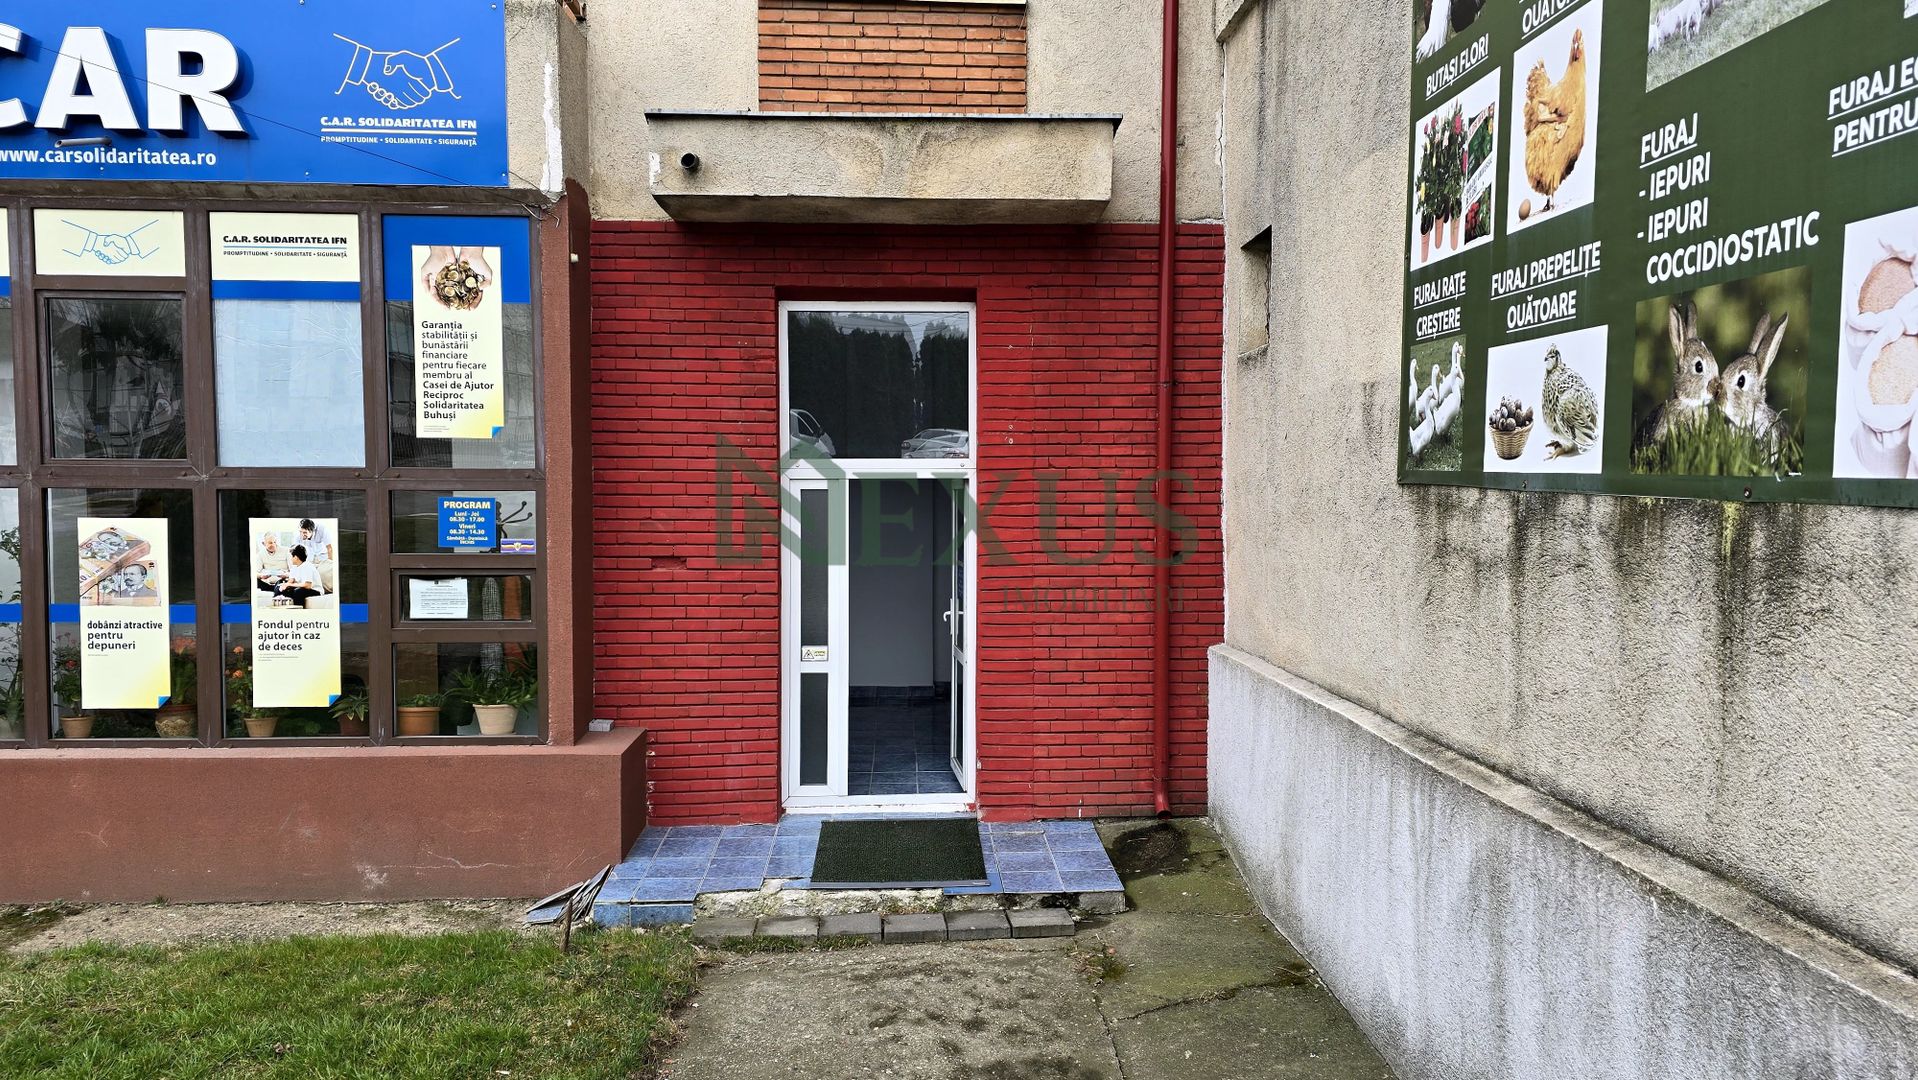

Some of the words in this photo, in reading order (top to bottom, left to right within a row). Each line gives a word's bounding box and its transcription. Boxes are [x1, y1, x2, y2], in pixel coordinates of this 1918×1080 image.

[1460, 33, 1489, 71] FLORI
[1829, 64, 1895, 115] FURAJ
[1900, 56, 1918, 88] E
[320, 117, 356, 126] C.A.R.
[358, 117, 453, 129] SOLIDARITATEA
[456, 119, 477, 129] IFN
[1833, 97, 1918, 152] PENTRU
[320, 136, 378, 144] PROMPTITUDINE
[384, 137, 433, 145] SOLIDARITATE
[1640, 112, 1698, 163] FURAJ
[1650, 152, 1711, 201] IEPURI
[1648, 197, 1709, 243] IEPURI
[223, 235, 251, 243] C.A.R.
[253, 235, 330, 244] SOLIDARITATEA
[331, 237, 347, 245] IFN
[1646, 210, 1820, 285] COCCIDIOSTATIC
[1491, 264, 1528, 296] FURAJ
[1414, 278, 1440, 307] FURAJ
[1507, 290, 1577, 329] OUĂTOARE
[422, 340, 469, 350] bunăstării
[422, 350, 468, 359] financiare
[422, 361, 454, 371] pentru
[455, 361, 487, 370] fiecare
[422, 371, 462, 379] membru
[464, 371, 473, 379] al
[423, 381, 448, 389] Casei
[450, 381, 462, 390] de
[464, 381, 495, 391] Ajutor
[423, 391, 464, 401] Reciproc
[423, 400, 484, 410] Solidaritatea
[443, 501, 491, 509] PROGRAM
[87, 620, 122, 629] dobânzi
[123, 621, 163, 630] atractive
[257, 620, 293, 629] Fondul
[296, 621, 330, 630] pentru
[87, 632, 123, 641] pentru
[258, 631, 289, 642] ajutor
[291, 630, 301, 640] în
[304, 632, 321, 640] caz
[87, 640, 136, 651] depuneri
[258, 642, 271, 651] de
[273, 642, 303, 651] deces
